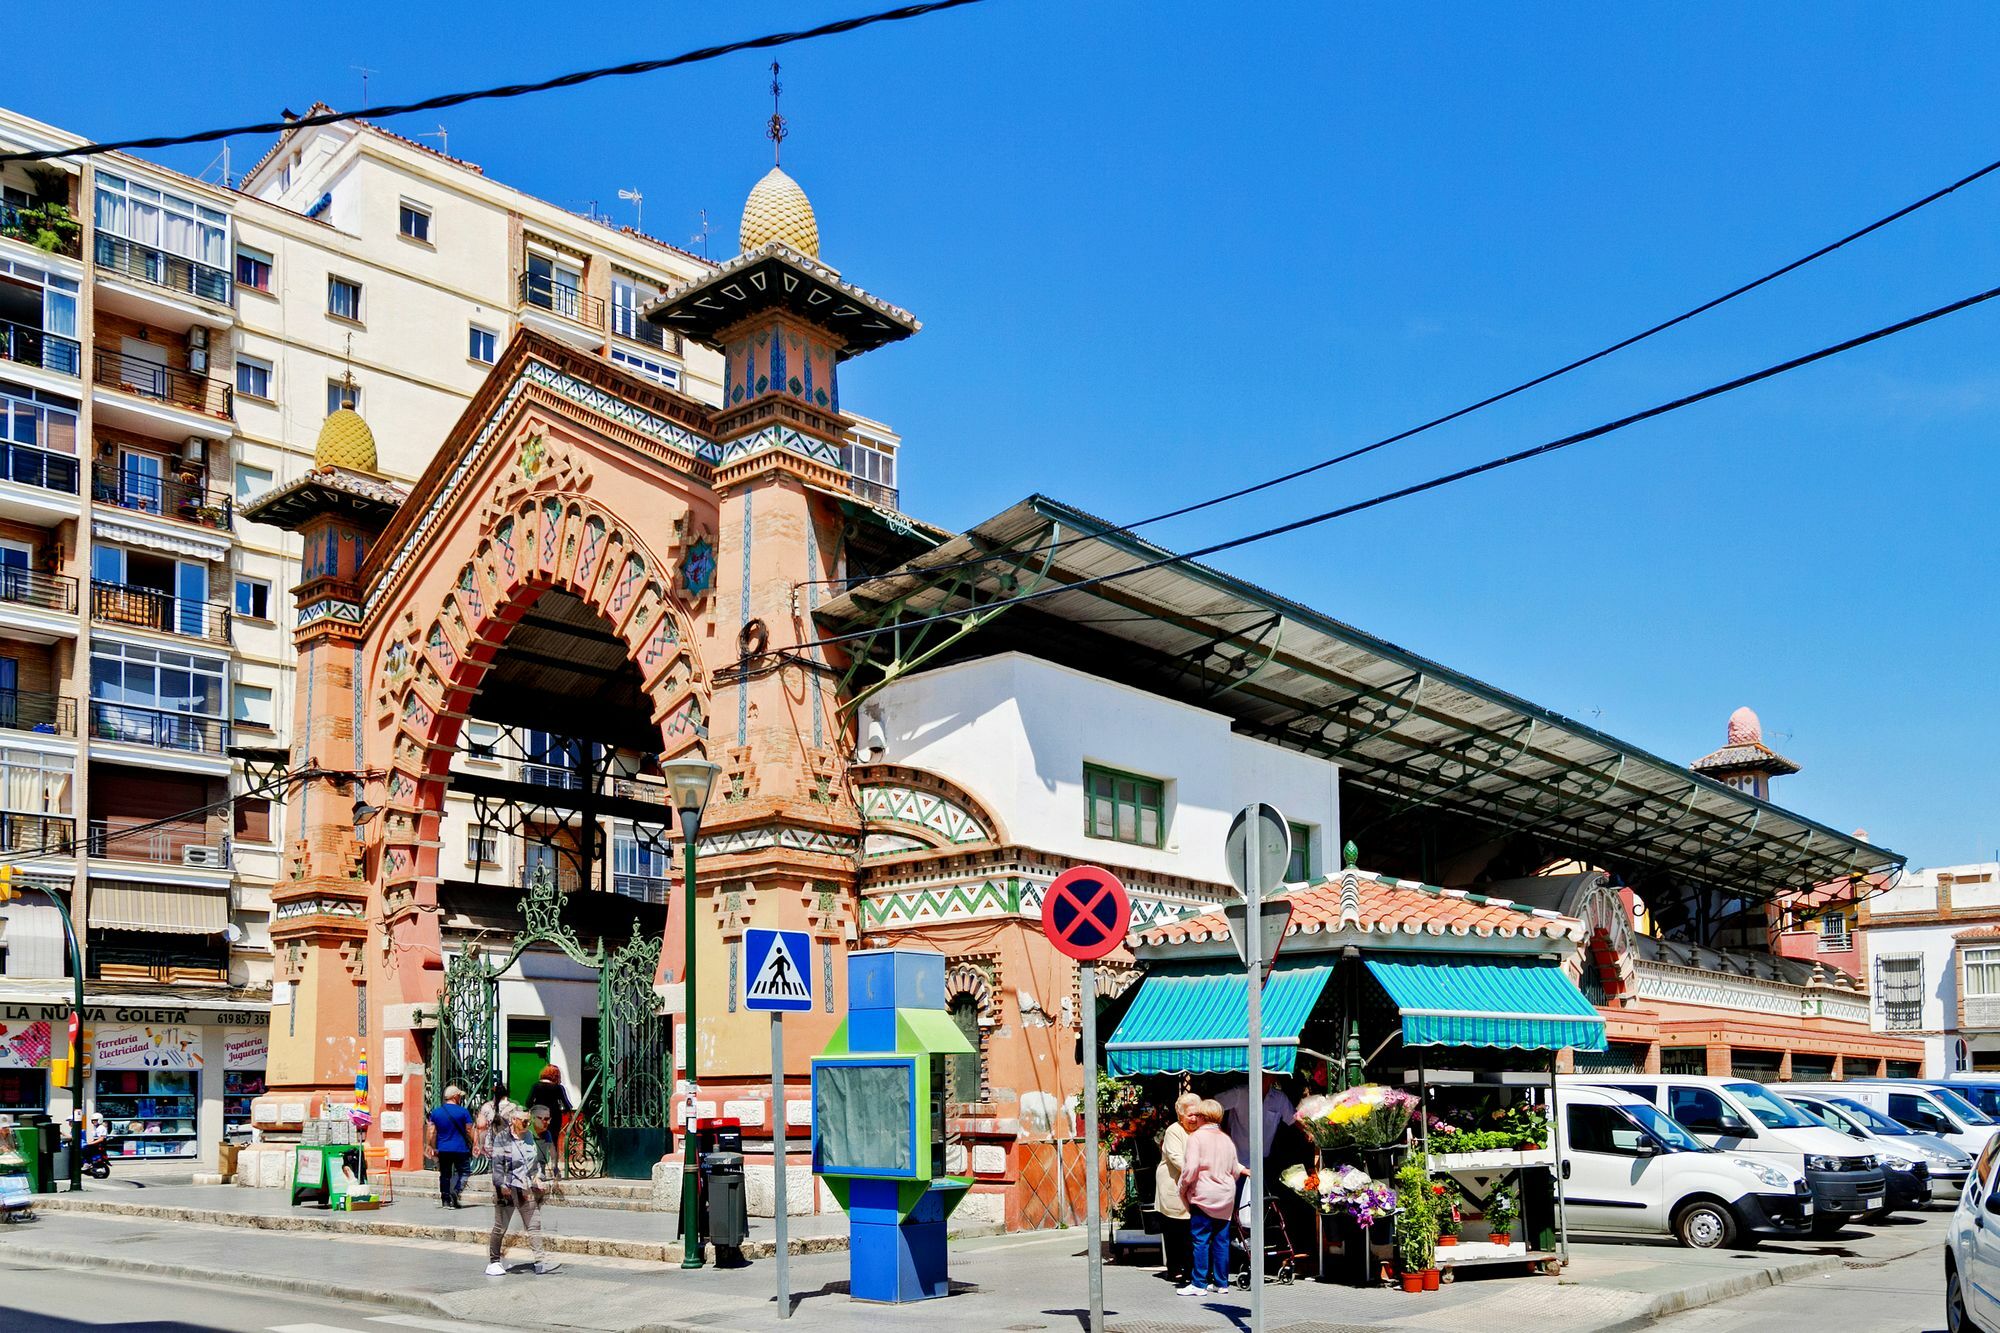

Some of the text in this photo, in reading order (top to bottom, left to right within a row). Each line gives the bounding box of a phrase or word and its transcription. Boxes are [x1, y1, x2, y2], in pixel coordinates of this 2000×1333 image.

[6, 1006, 186, 1022] LA NUVA GOLETA
[217, 1013, 270, 1024] 619 857 351
[99, 1042, 149, 1059] Electricidad
